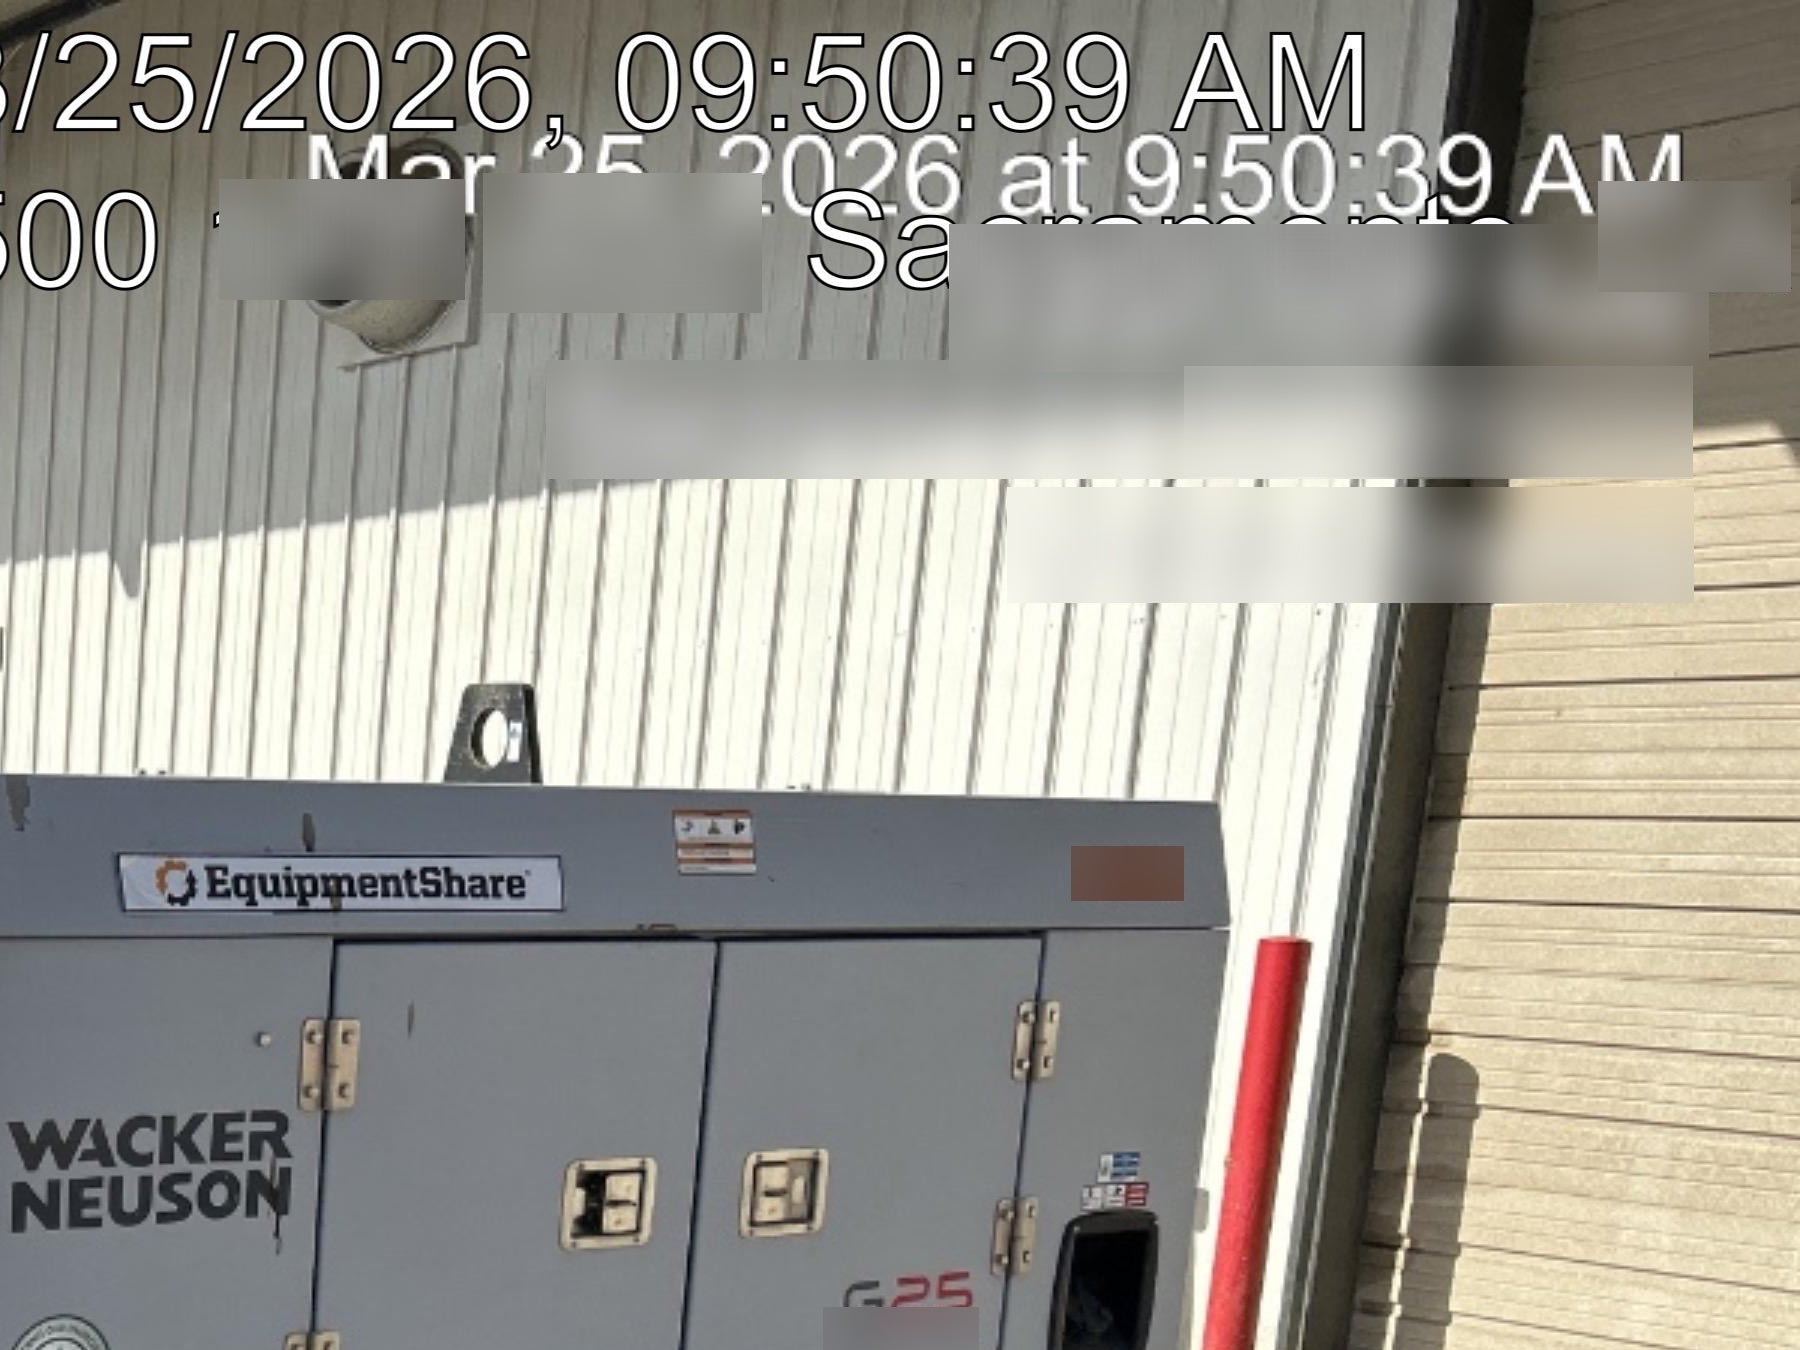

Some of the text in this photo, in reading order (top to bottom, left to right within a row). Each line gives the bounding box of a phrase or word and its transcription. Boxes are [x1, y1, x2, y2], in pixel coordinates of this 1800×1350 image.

[204, 865, 527, 907] EquipmentShare
[7, 1109, 293, 1172] WACKER
[11, 1166, 292, 1233] NEUSON
